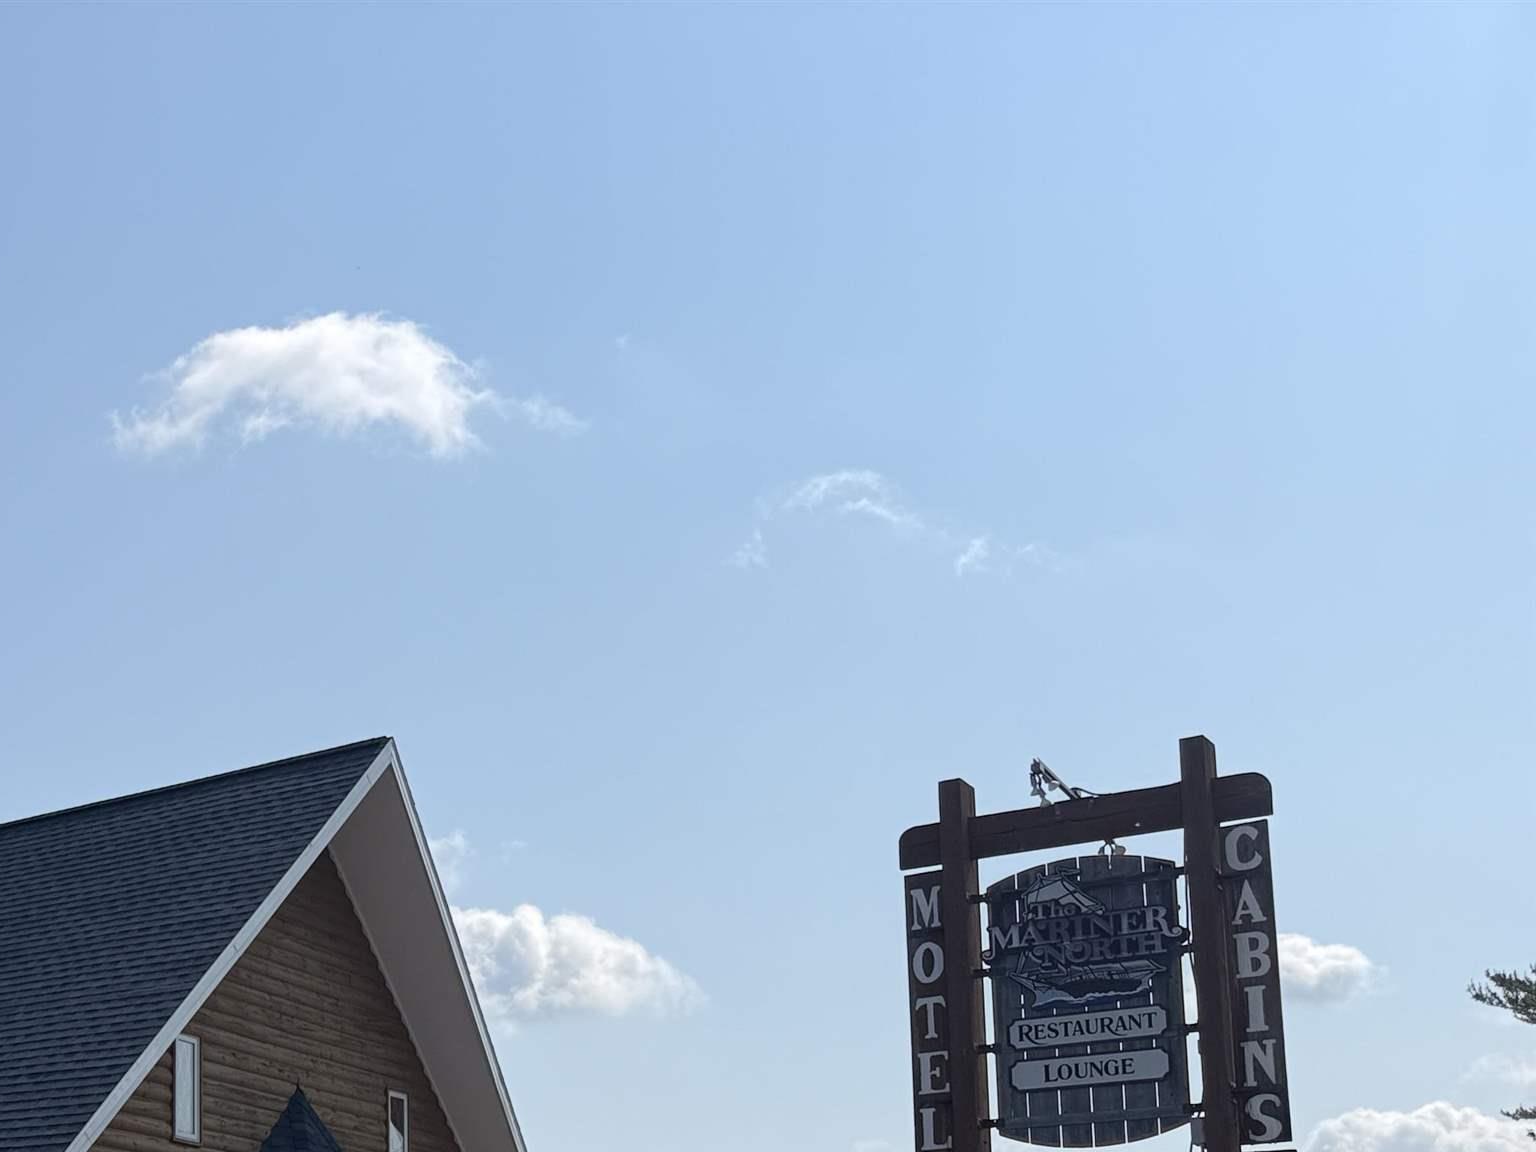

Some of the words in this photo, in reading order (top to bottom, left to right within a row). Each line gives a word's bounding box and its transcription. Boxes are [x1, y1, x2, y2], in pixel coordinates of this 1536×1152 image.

[1029, 902, 1079, 920] The
[982, 906, 1183, 960] MARINER
[1030, 932, 1167, 972] NORTH
[1224, 825, 1283, 1143] CABINS
[910, 885, 953, 1151] MOTEL
[1017, 1012, 1157, 1045] RESTAURANT
[1043, 1057, 1136, 1083] LOUNGE
